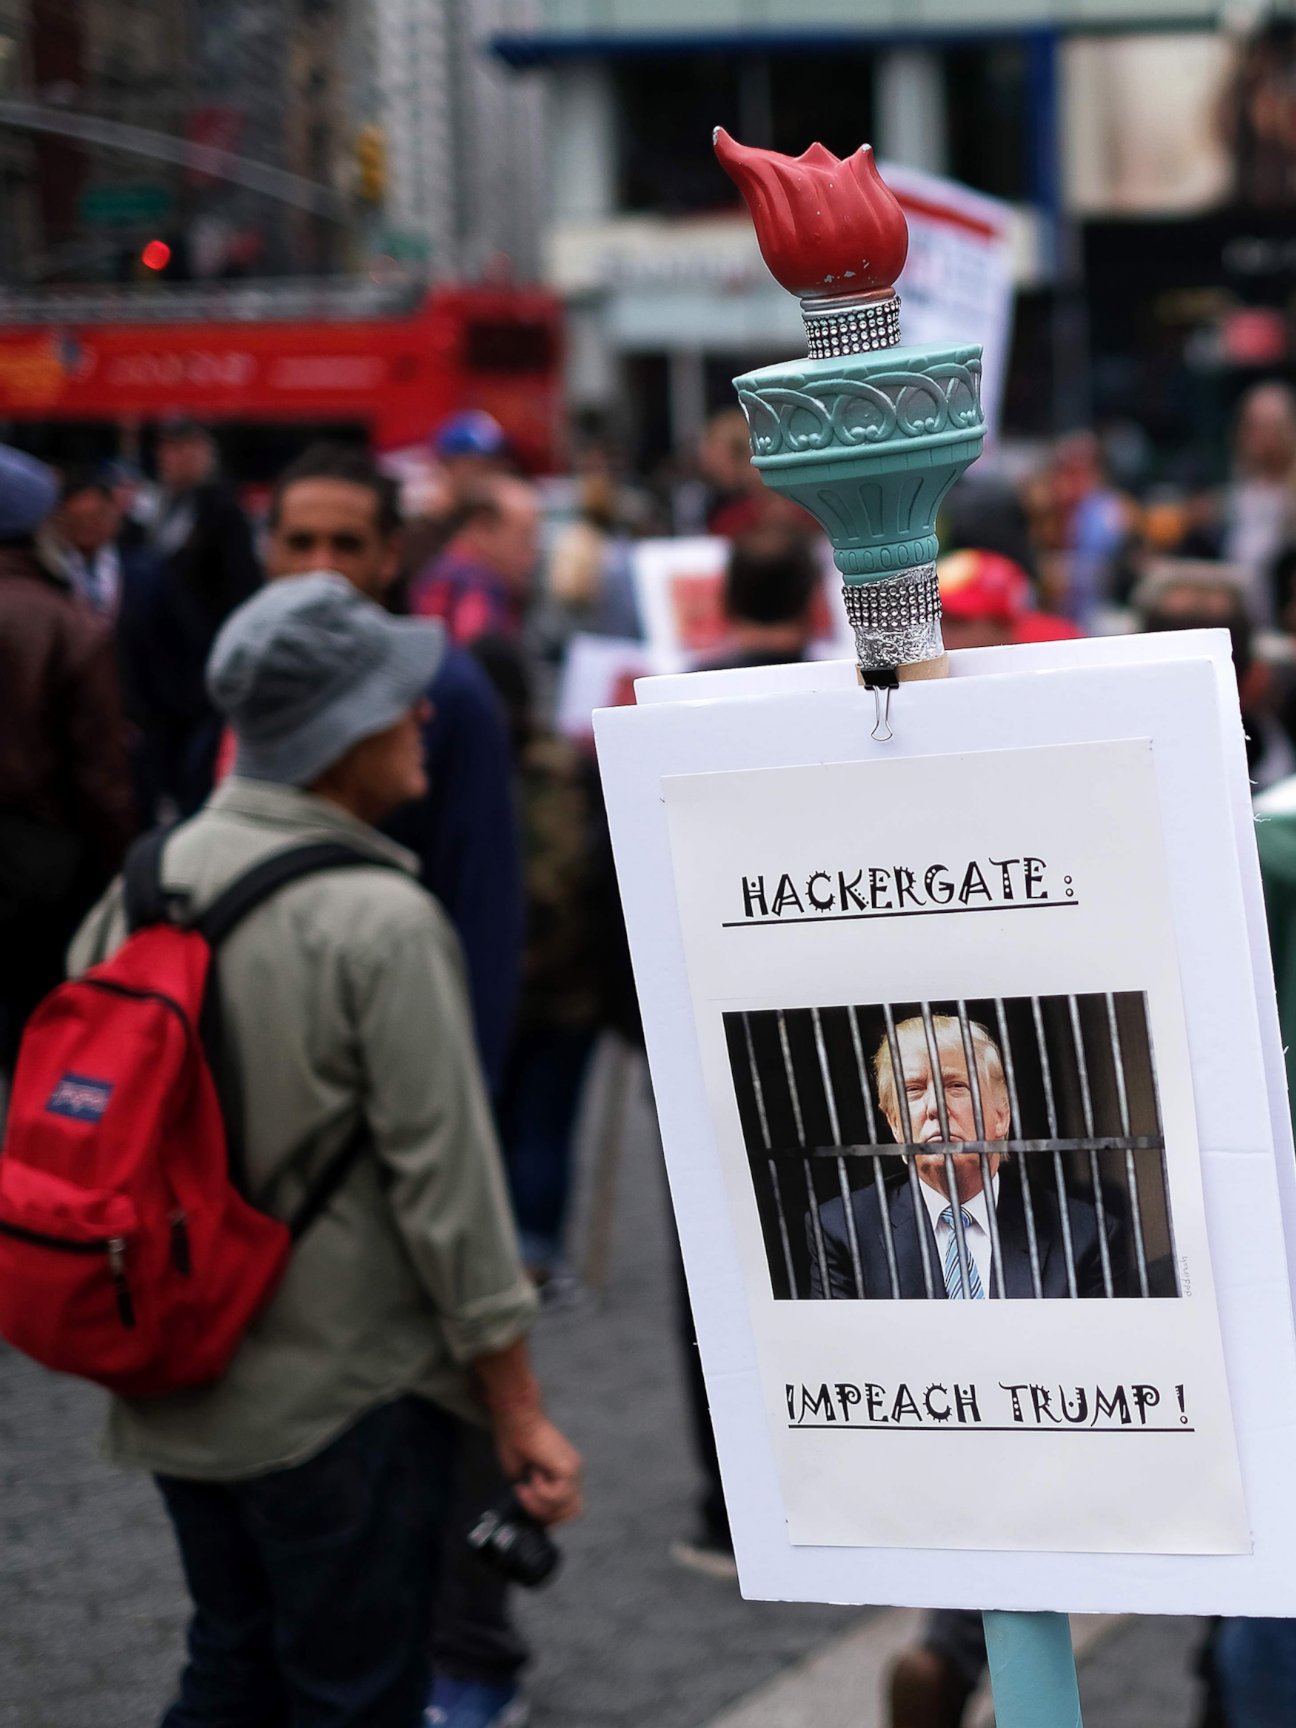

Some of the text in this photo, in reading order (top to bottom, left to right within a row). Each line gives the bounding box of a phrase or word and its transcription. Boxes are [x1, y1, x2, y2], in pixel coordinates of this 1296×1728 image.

[741, 856, 1074, 918] HACKERGATE:
[785, 1381, 1190, 1426] IMPEACH TRUMP!
